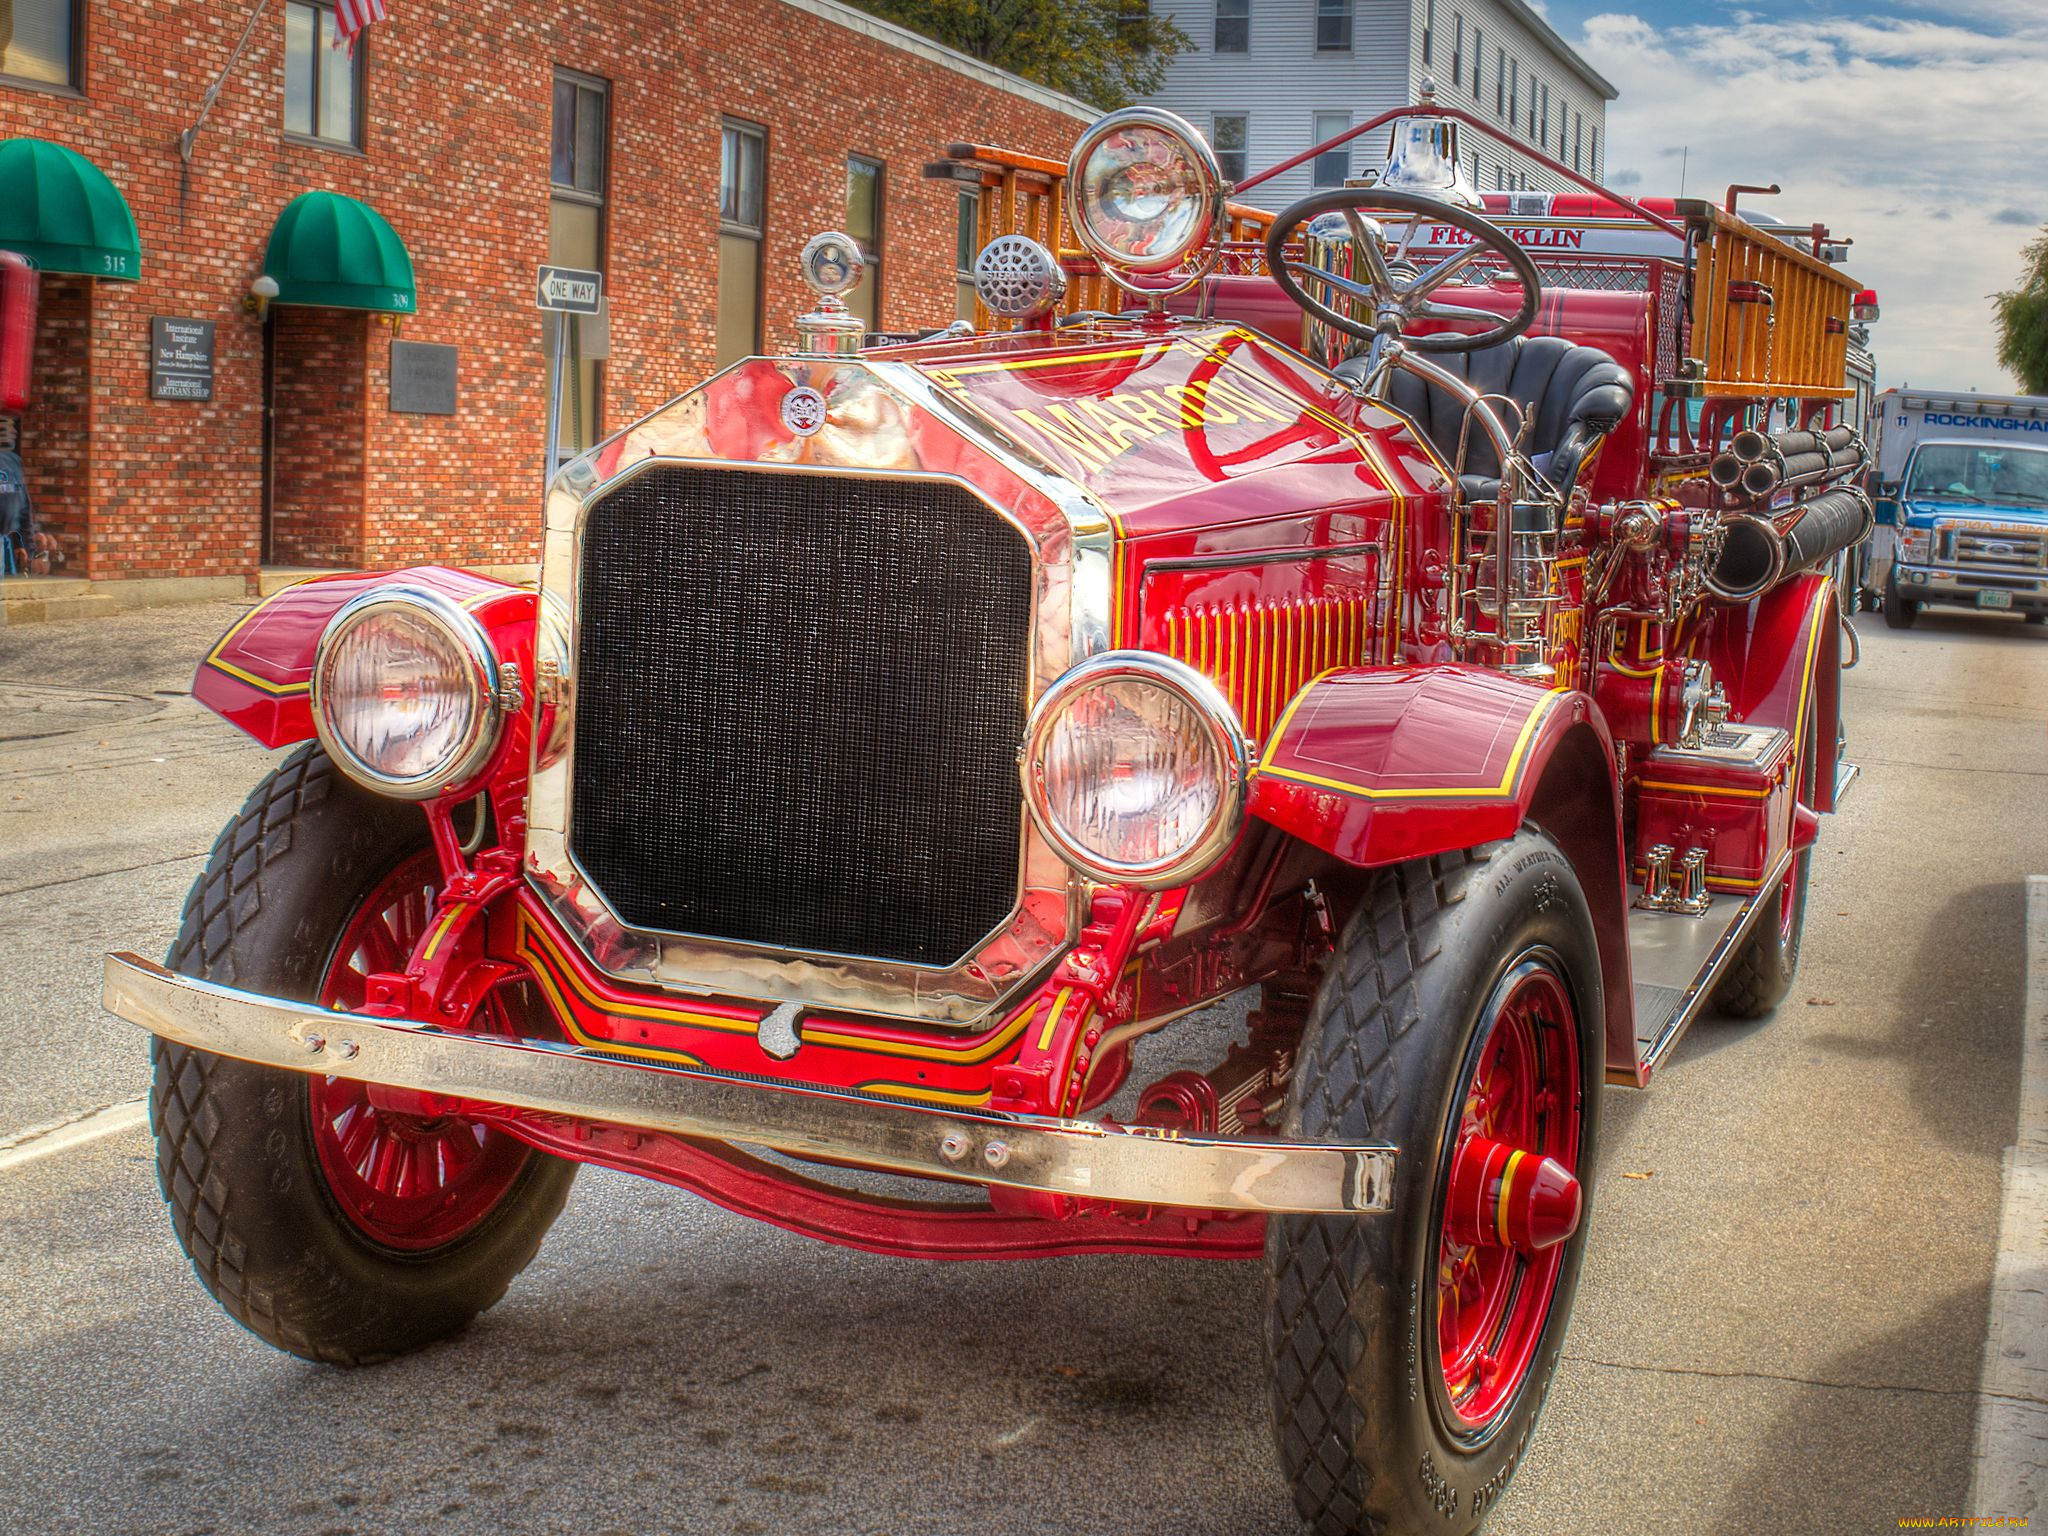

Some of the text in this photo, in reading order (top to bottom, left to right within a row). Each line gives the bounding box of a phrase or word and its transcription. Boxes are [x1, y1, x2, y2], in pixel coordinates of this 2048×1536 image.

[1428, 226, 1585, 249] FRAKLIN
[104, 255, 126, 273] 315
[986, 269, 1035, 281] STERLING
[550, 280, 593, 300] ONE WAY
[392, 293, 409, 308] 309
[165, 322, 204, 335] International
[172, 332, 198, 344] Institute
[160, 348, 208, 361] New Hampshire
[166, 376, 202, 388] International
[158, 386, 210, 398] ARTISANS SHOP
[1011, 377, 1297, 475] MARION
[1897, 415, 1908, 427] 11
[1924, 411, 2048, 433] ROCKINGHA
